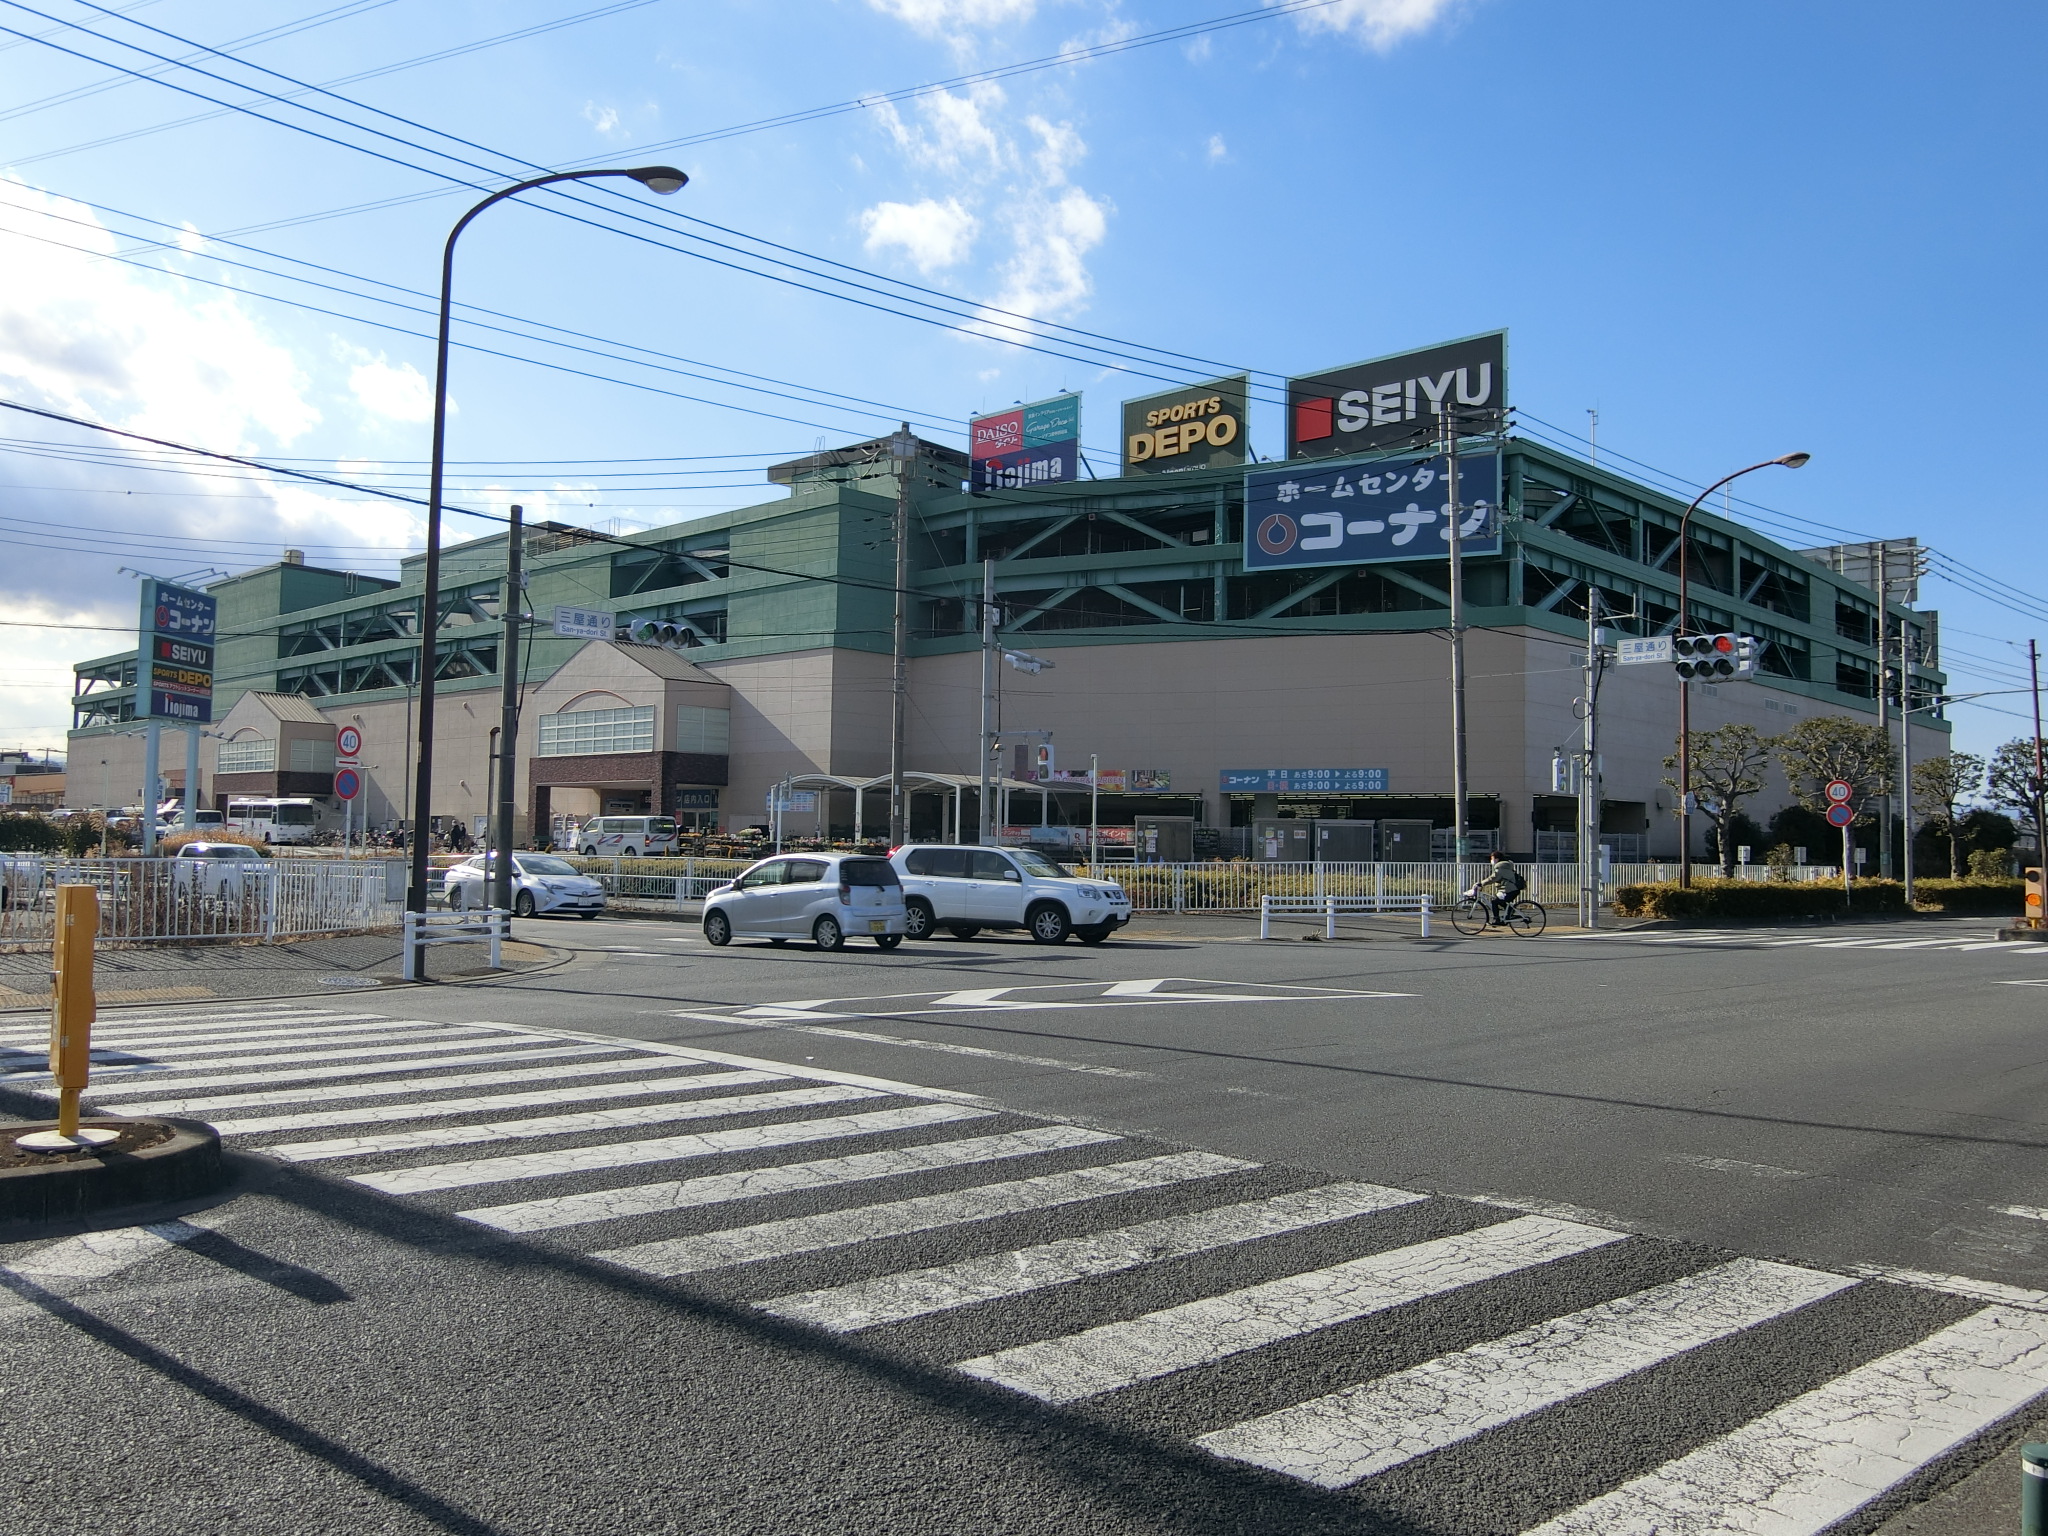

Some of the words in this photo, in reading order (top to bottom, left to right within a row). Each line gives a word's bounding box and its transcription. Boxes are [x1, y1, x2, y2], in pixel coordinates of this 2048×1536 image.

[1337, 362, 1492, 433] SEIYU
[1146, 396, 1221, 427] SPORTS
[977, 422, 1018, 441] DAISO
[1129, 414, 1237, 464] DEPO
[1277, 468, 1464, 502] ホームセンター
[1300, 500, 1487, 550] コーナン
[161, 592, 211, 611] ホームセンター
[169, 610, 214, 636] コーナン
[561, 625, 598, 636] San-ya-dori
[172, 644, 206, 664] SEIYU
[1623, 653, 1654, 661] San-ya-dori
[153, 667, 178, 679] SPORTS
[178, 670, 212, 687] DEPO
[342, 734, 357, 749] 40
[1229, 776, 1260, 784] コーナン
[1831, 786, 1846, 797] 40
